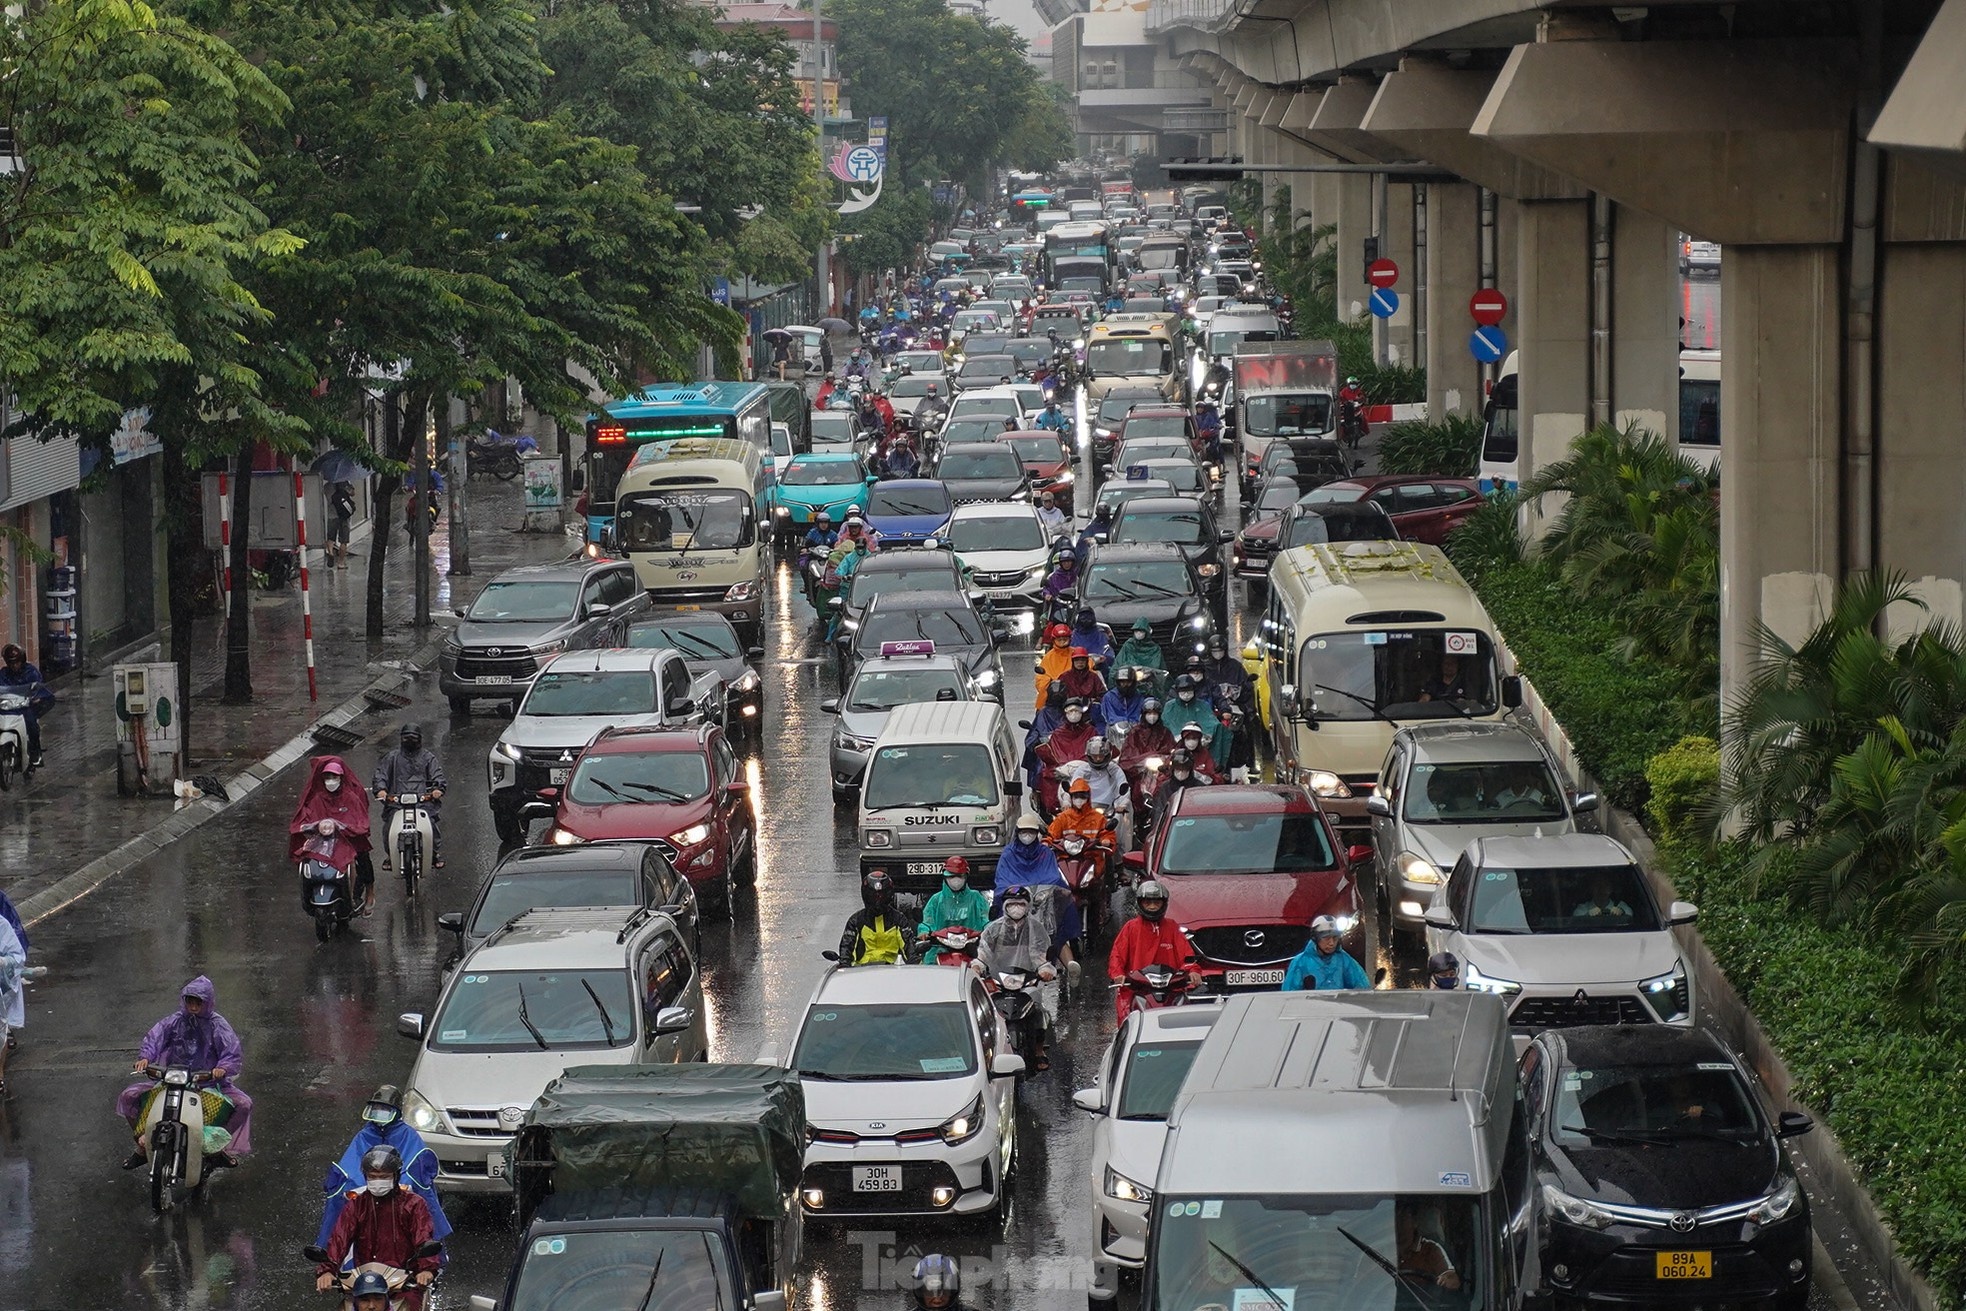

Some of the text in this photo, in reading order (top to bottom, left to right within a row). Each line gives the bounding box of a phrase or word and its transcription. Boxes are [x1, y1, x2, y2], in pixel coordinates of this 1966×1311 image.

[904, 815, 960, 825] SUZUKI
[908, 864, 944, 874] 29D-317
[1228, 971, 1284, 984] 30F-960.60
[866, 1167, 888, 1179] 30H
[858, 1179, 897, 1191] 459.83
[1672, 1252, 1696, 1265] 89A
[1662, 1265, 1706, 1278] 060.24
